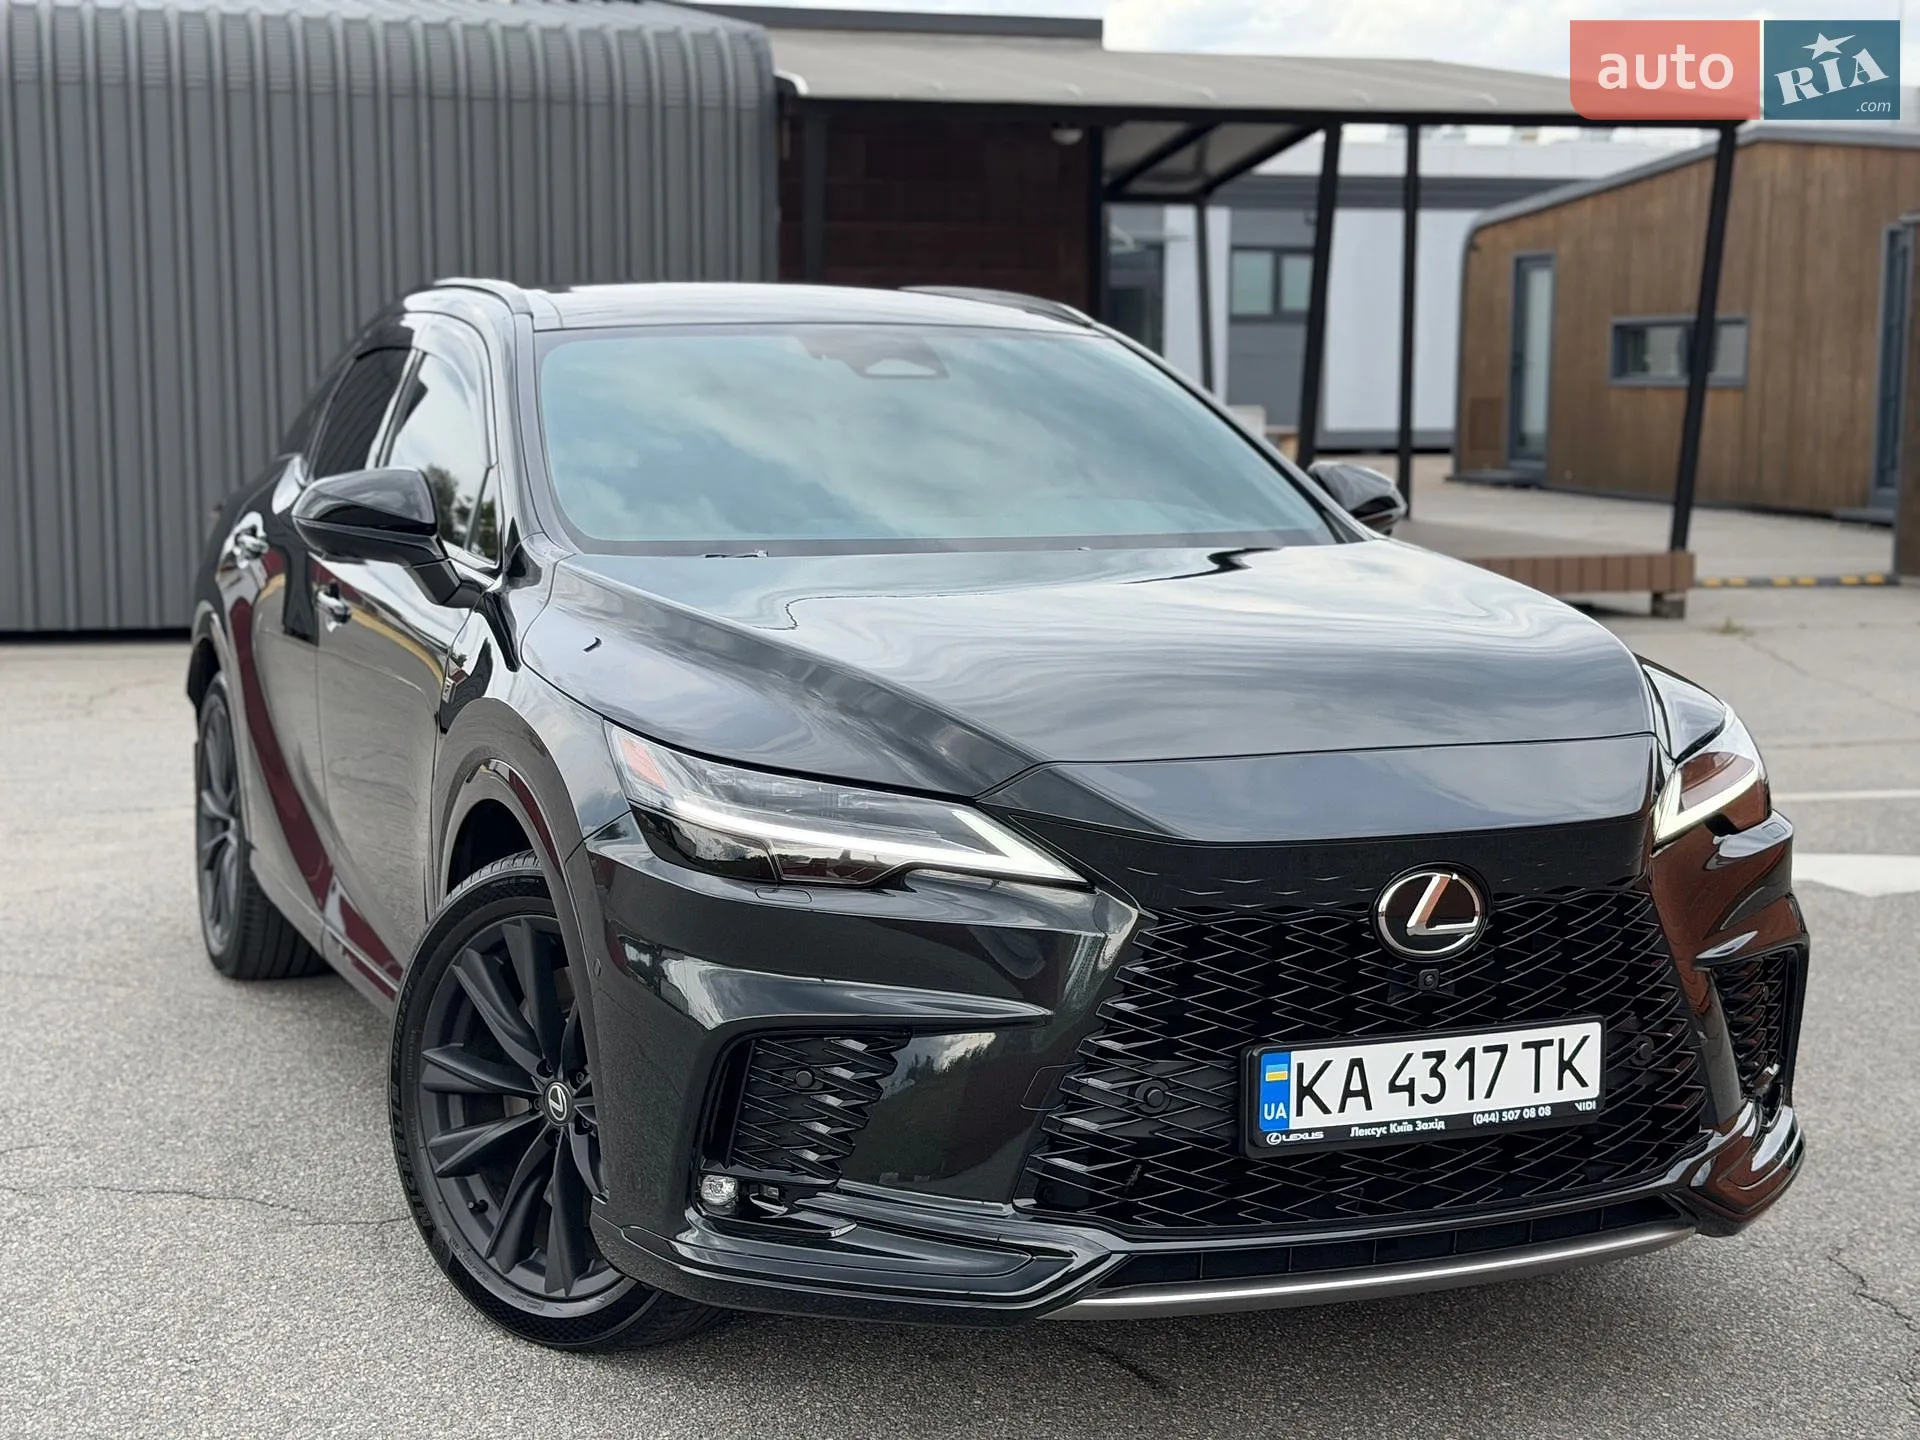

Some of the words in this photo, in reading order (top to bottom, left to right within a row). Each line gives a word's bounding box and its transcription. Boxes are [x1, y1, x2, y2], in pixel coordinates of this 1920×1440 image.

[1295, 1057, 1373, 1118] KA
[1388, 1044, 1508, 1107] 4317
[1521, 1034, 1591, 1094] TK
[1264, 1103, 1287, 1121] UA
[1472, 1111, 1499, 1126] (044)
[1502, 1109, 1521, 1122] 507
[1522, 1107, 1537, 1119] 08
[1282, 1131, 1324, 1142] LEXUS
